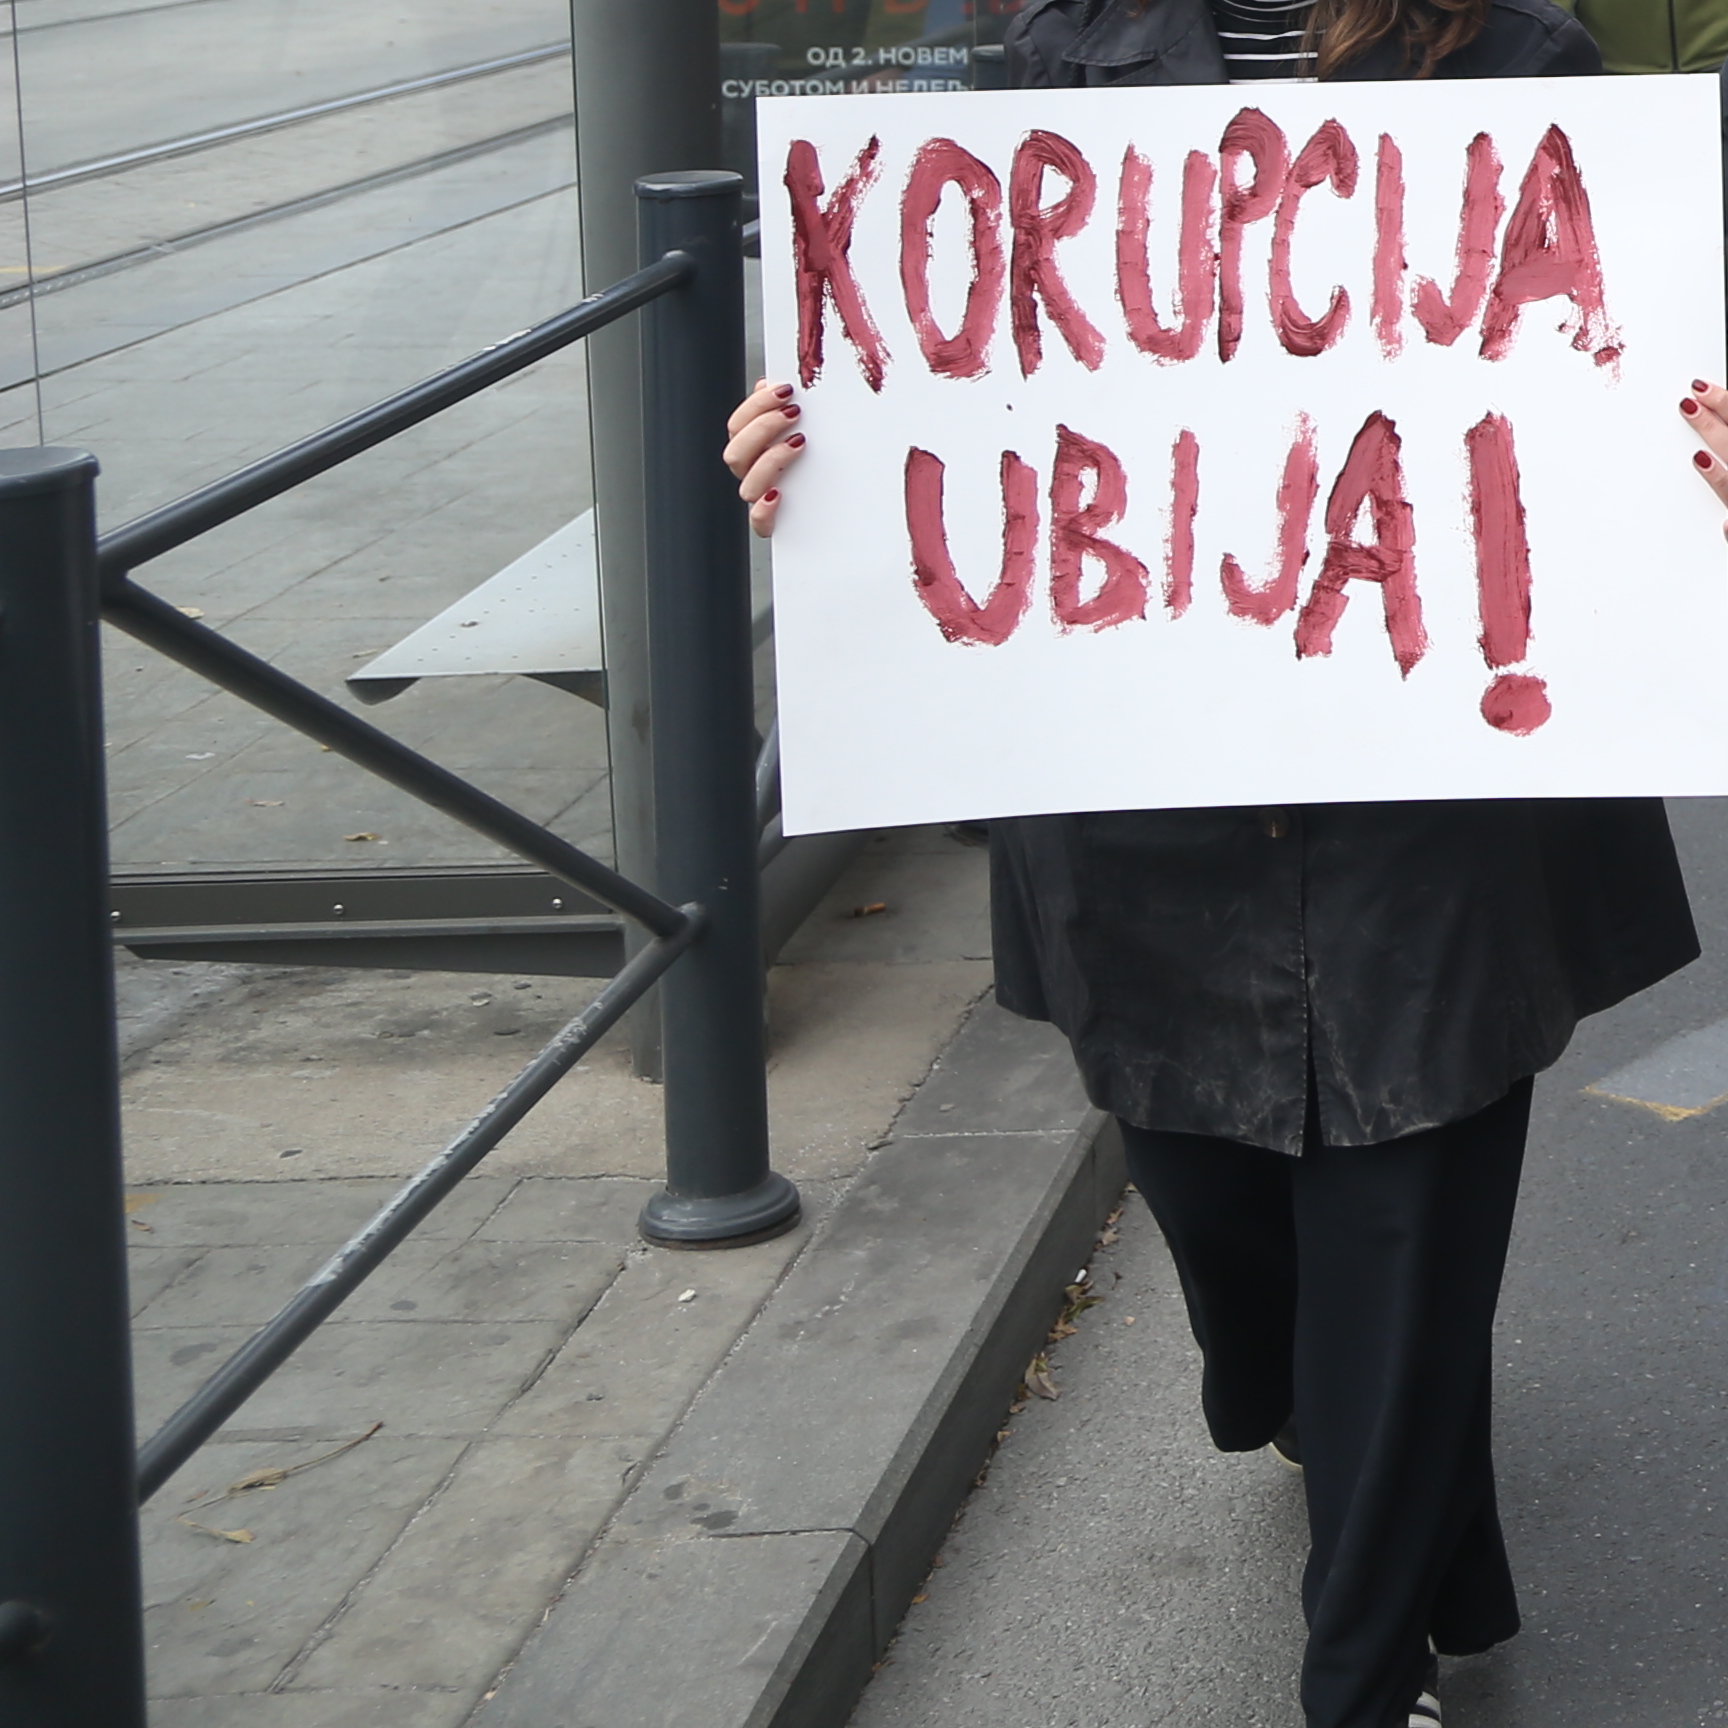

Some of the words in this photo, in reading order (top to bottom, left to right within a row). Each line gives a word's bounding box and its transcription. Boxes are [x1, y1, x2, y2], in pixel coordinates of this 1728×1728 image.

[721, 79, 845, 99] СУБОТОМ
[849, 78, 870, 96] И
[806, 46, 845, 69] ОД
[851, 46, 873, 65] 2.
[878, 46, 969, 65] НОВЕМ
[783, 106, 1626, 393] KORUPCIJA
[903, 409, 1553, 738] UBIJA!
